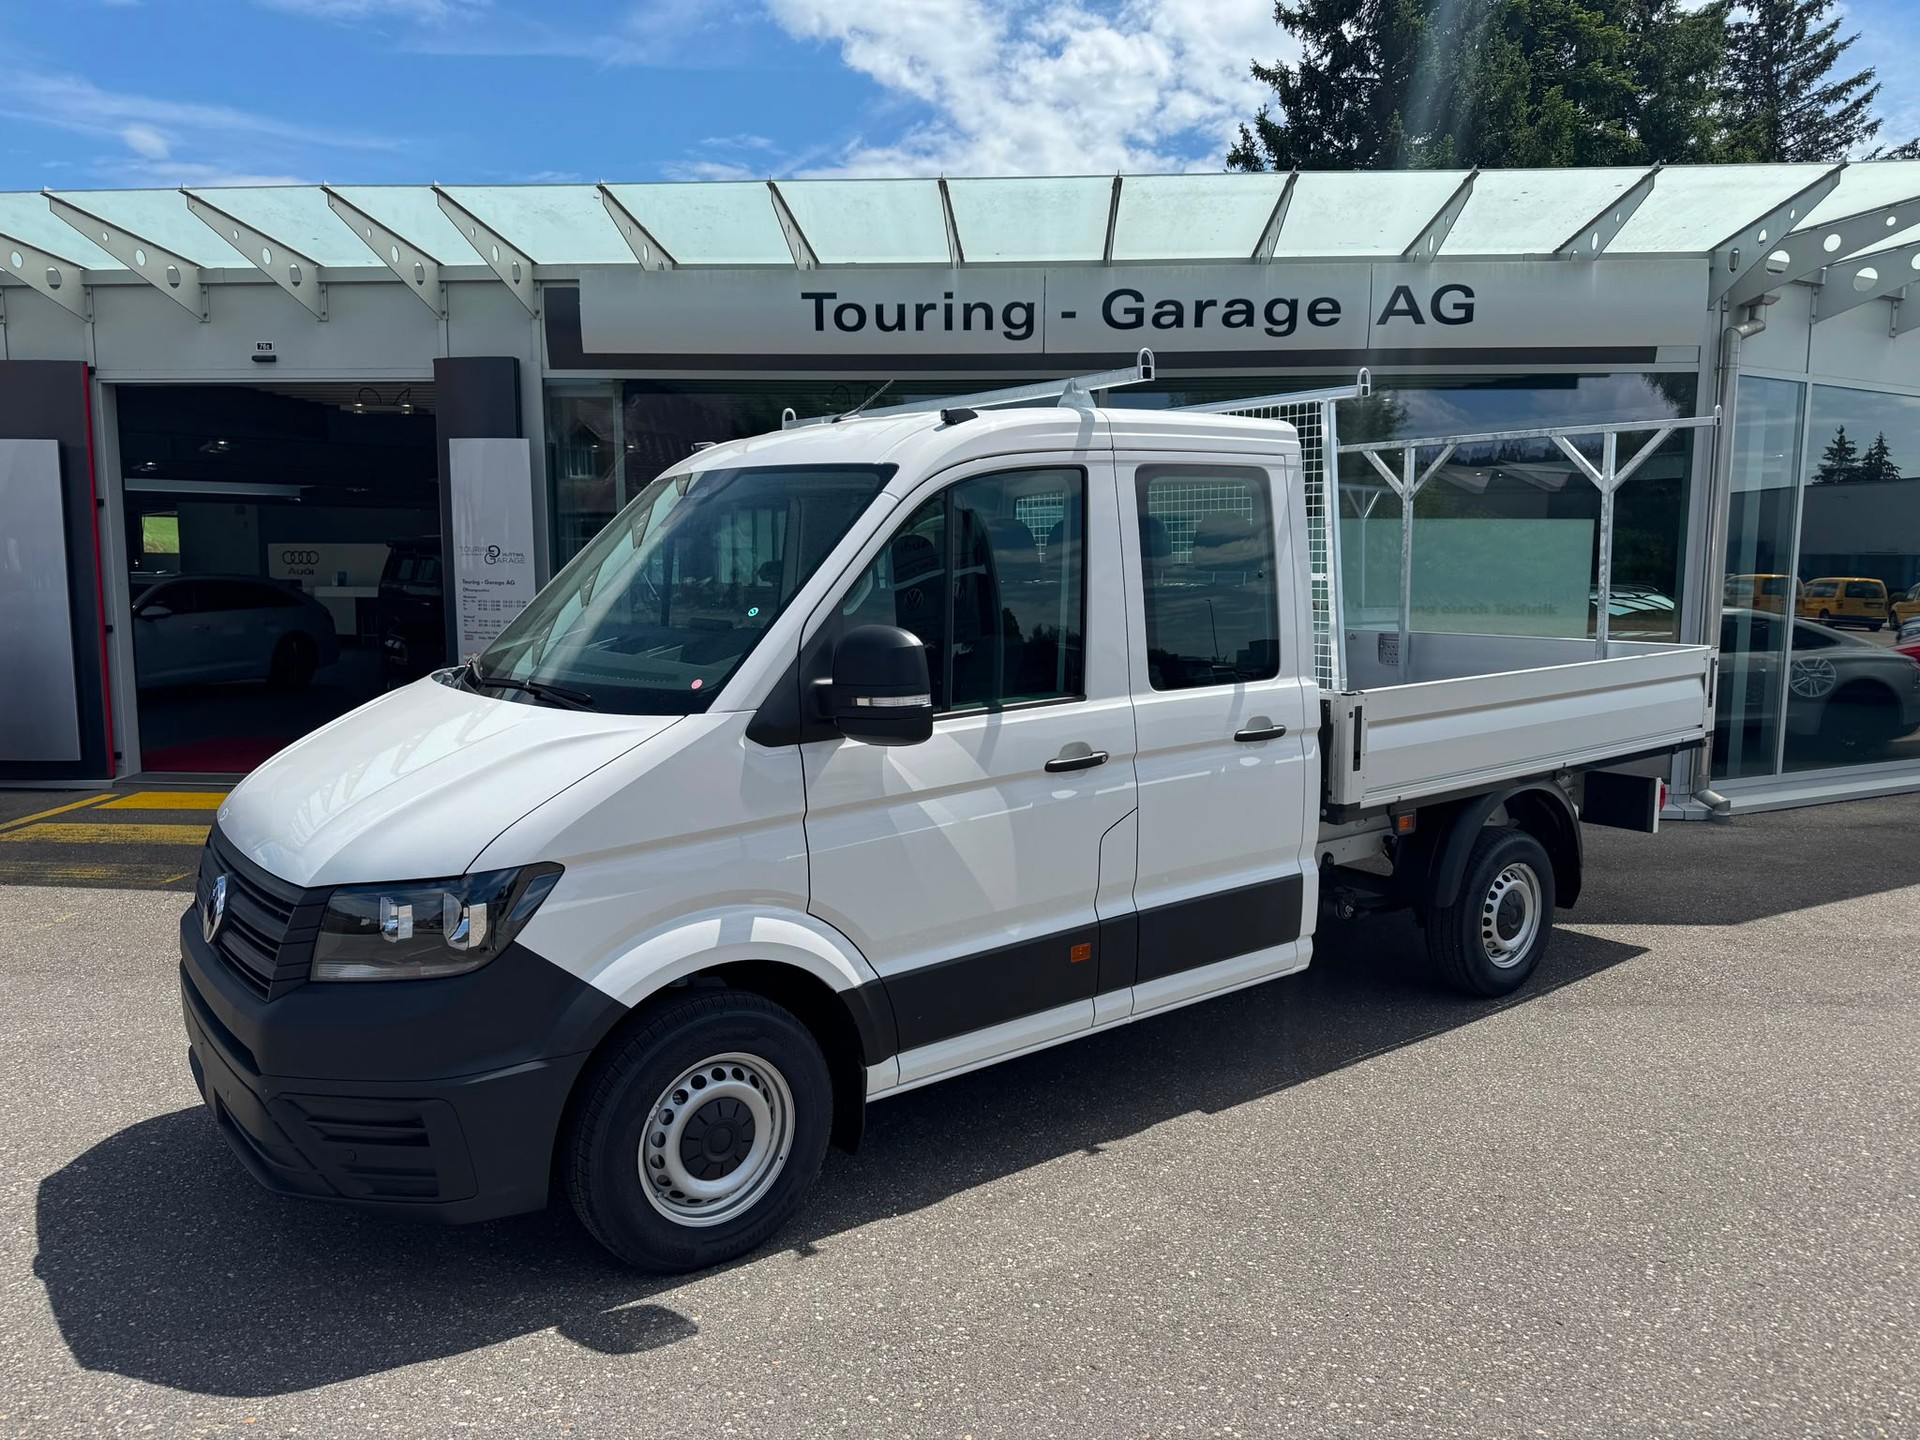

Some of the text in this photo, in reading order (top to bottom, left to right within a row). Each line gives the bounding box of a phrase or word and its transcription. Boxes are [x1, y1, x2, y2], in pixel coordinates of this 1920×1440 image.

[801, 283, 1475, 341] Touring - Garage AG
[287, 567, 314, 576] Audi
[462, 578, 480, 586] Touring
[484, 579, 505, 587] Garage
